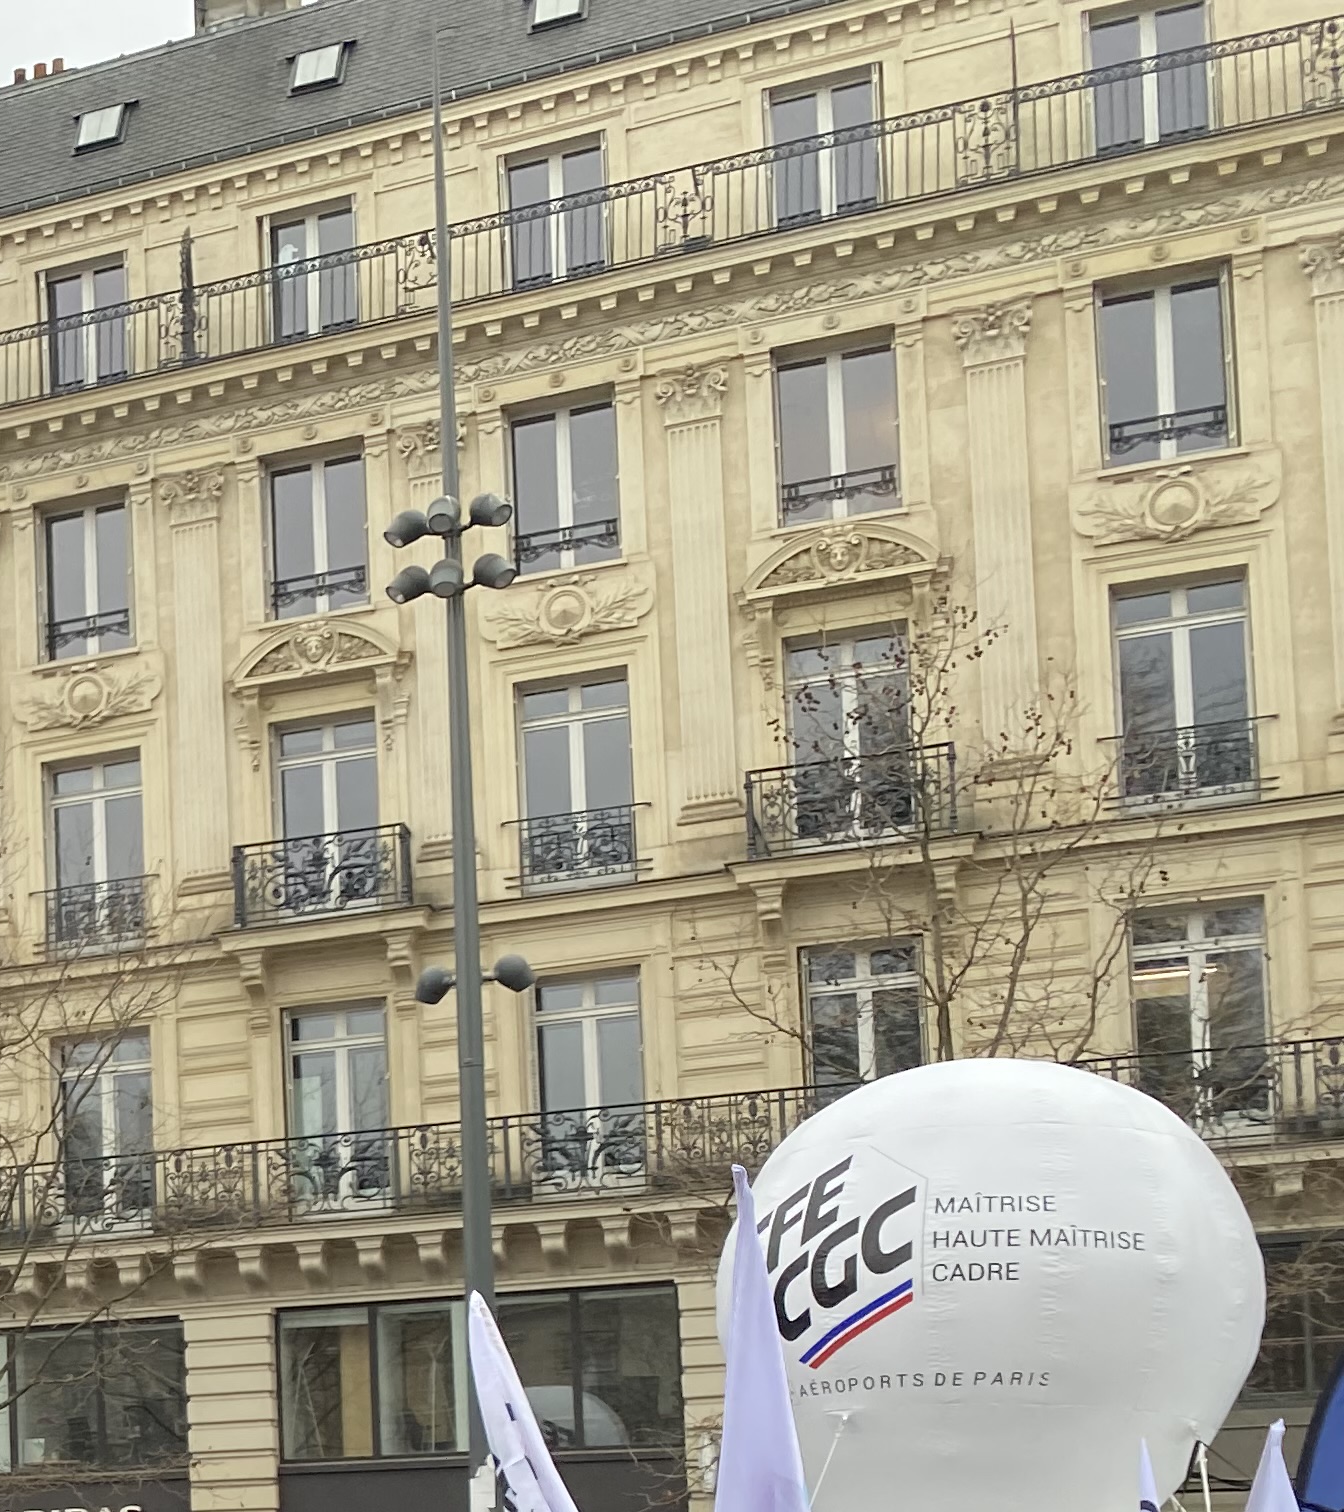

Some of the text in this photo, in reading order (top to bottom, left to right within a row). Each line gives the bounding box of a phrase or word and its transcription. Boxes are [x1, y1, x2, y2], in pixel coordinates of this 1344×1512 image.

[934, 1192, 1057, 1214] MAÎTRISE
[933, 1225, 1146, 1251] HAUTE MAÎTRISE
[774, 1185, 917, 1341] CGC
[932, 1262, 1020, 1282] CADRE
[799, 1371, 1051, 1398] AÉROPORTS DE PARIS
